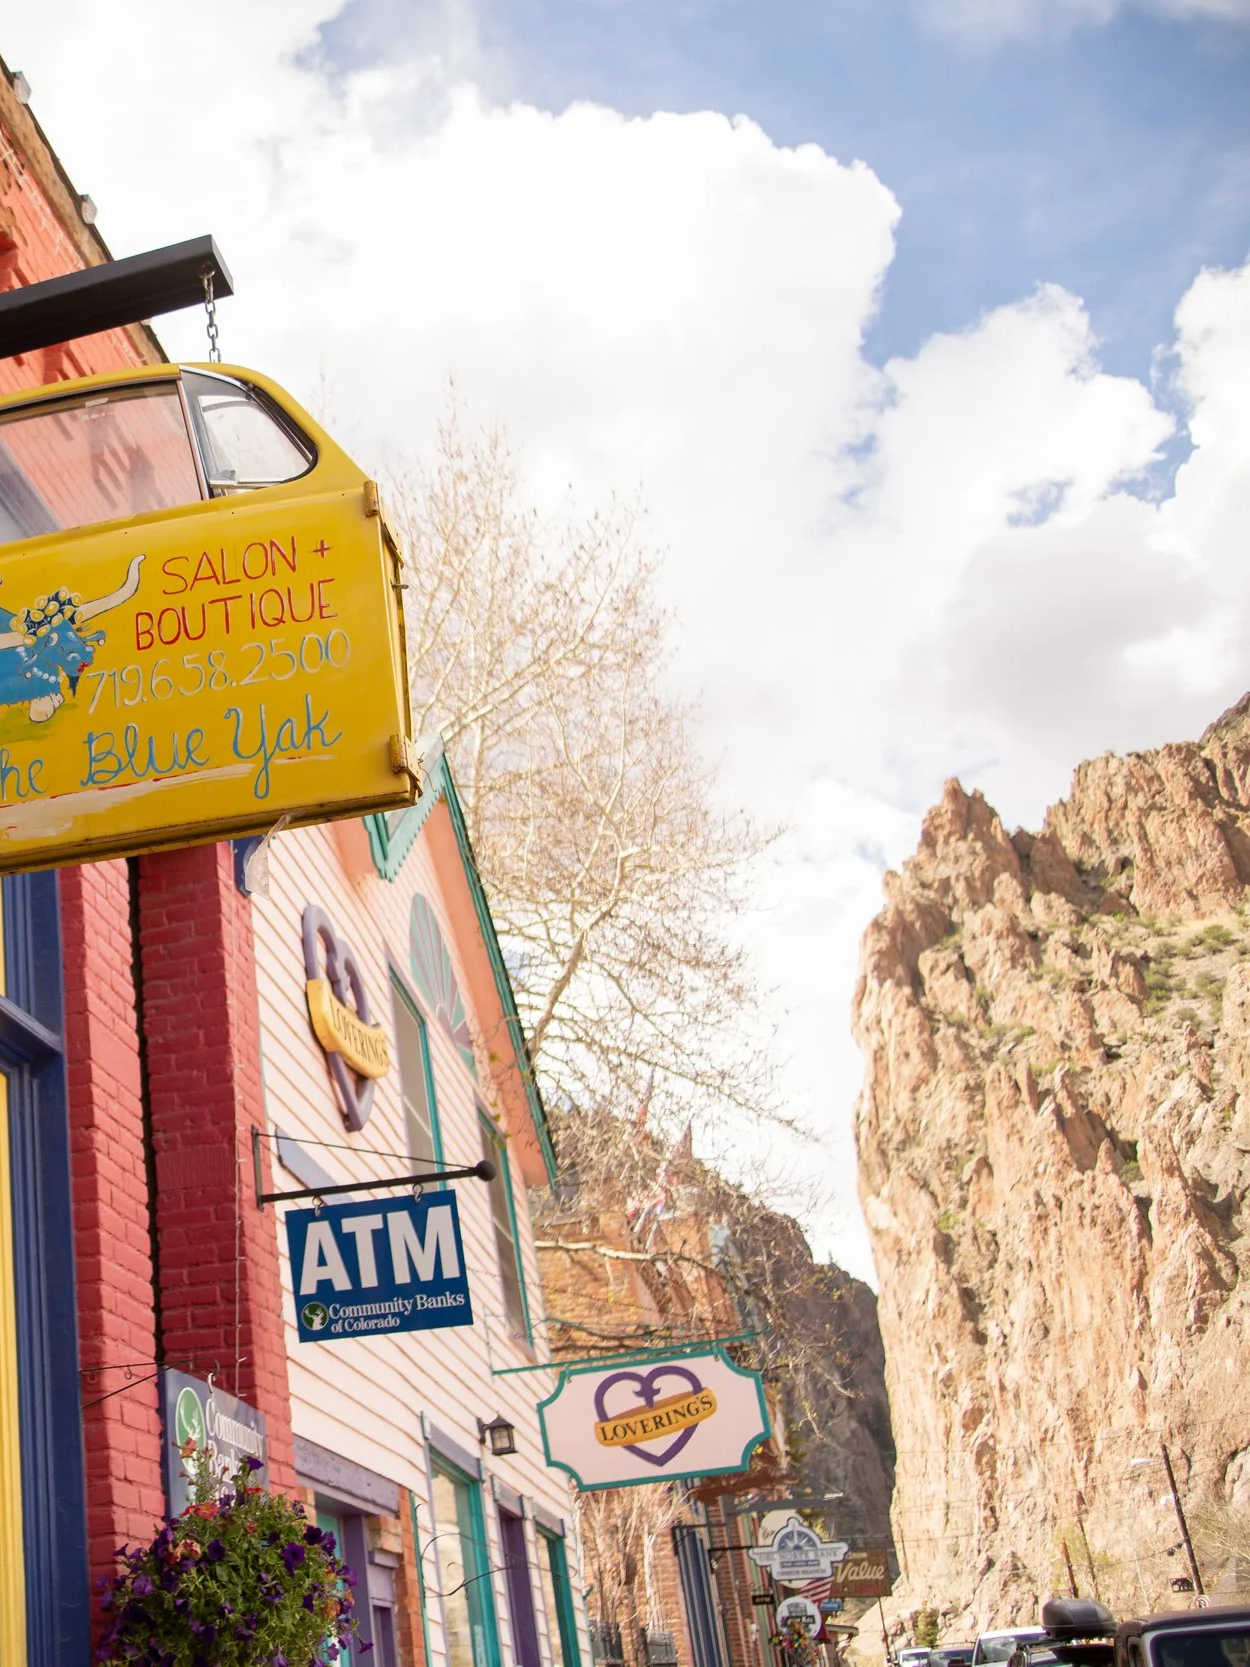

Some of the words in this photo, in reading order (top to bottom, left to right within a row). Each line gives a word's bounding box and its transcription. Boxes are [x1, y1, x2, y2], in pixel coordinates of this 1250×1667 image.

[162, 536, 297, 595] SALON
[135, 578, 338, 650] BOUTIQUE
[86, 629, 350, 714] 719.658.2500
[80, 723, 209, 787] Blue
[224, 693, 343, 800] Yak
[299, 1204, 461, 1296] ATM
[328, 1297, 413, 1320] Community
[414, 1291, 466, 1310] Banks
[330, 1324, 344, 1334] of
[344, 1315, 400, 1331] Colorado
[600, 1394, 713, 1441] LOVERING'S
[207, 1439, 243, 1483] Bank
[834, 1560, 885, 1583] Value
